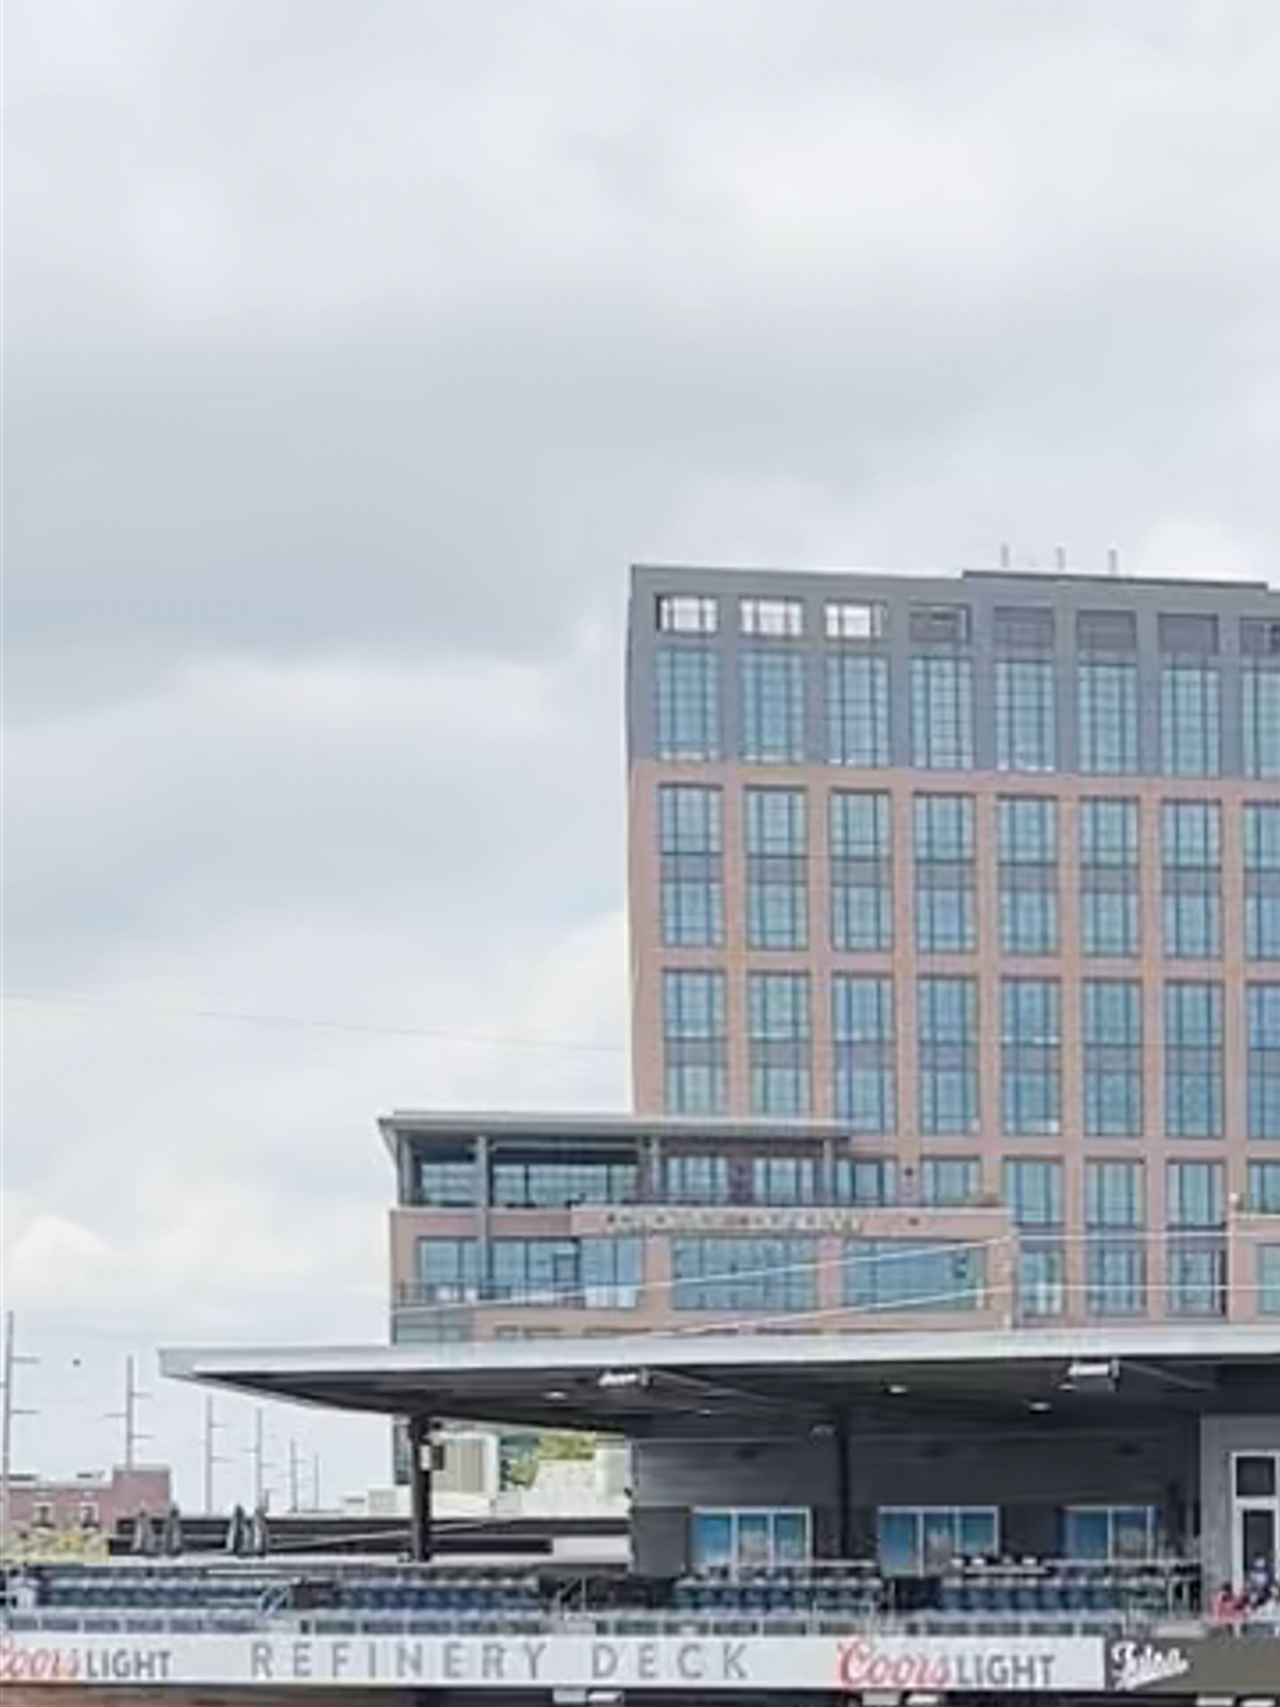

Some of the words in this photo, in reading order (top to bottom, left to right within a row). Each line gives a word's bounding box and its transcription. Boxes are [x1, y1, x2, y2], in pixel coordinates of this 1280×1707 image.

[86, 1648, 171, 1678] LIGHT
[251, 1641, 547, 1679] REFINERY
[591, 1642, 749, 1679] DECK
[956, 1654, 1055, 1685] LIGHT
